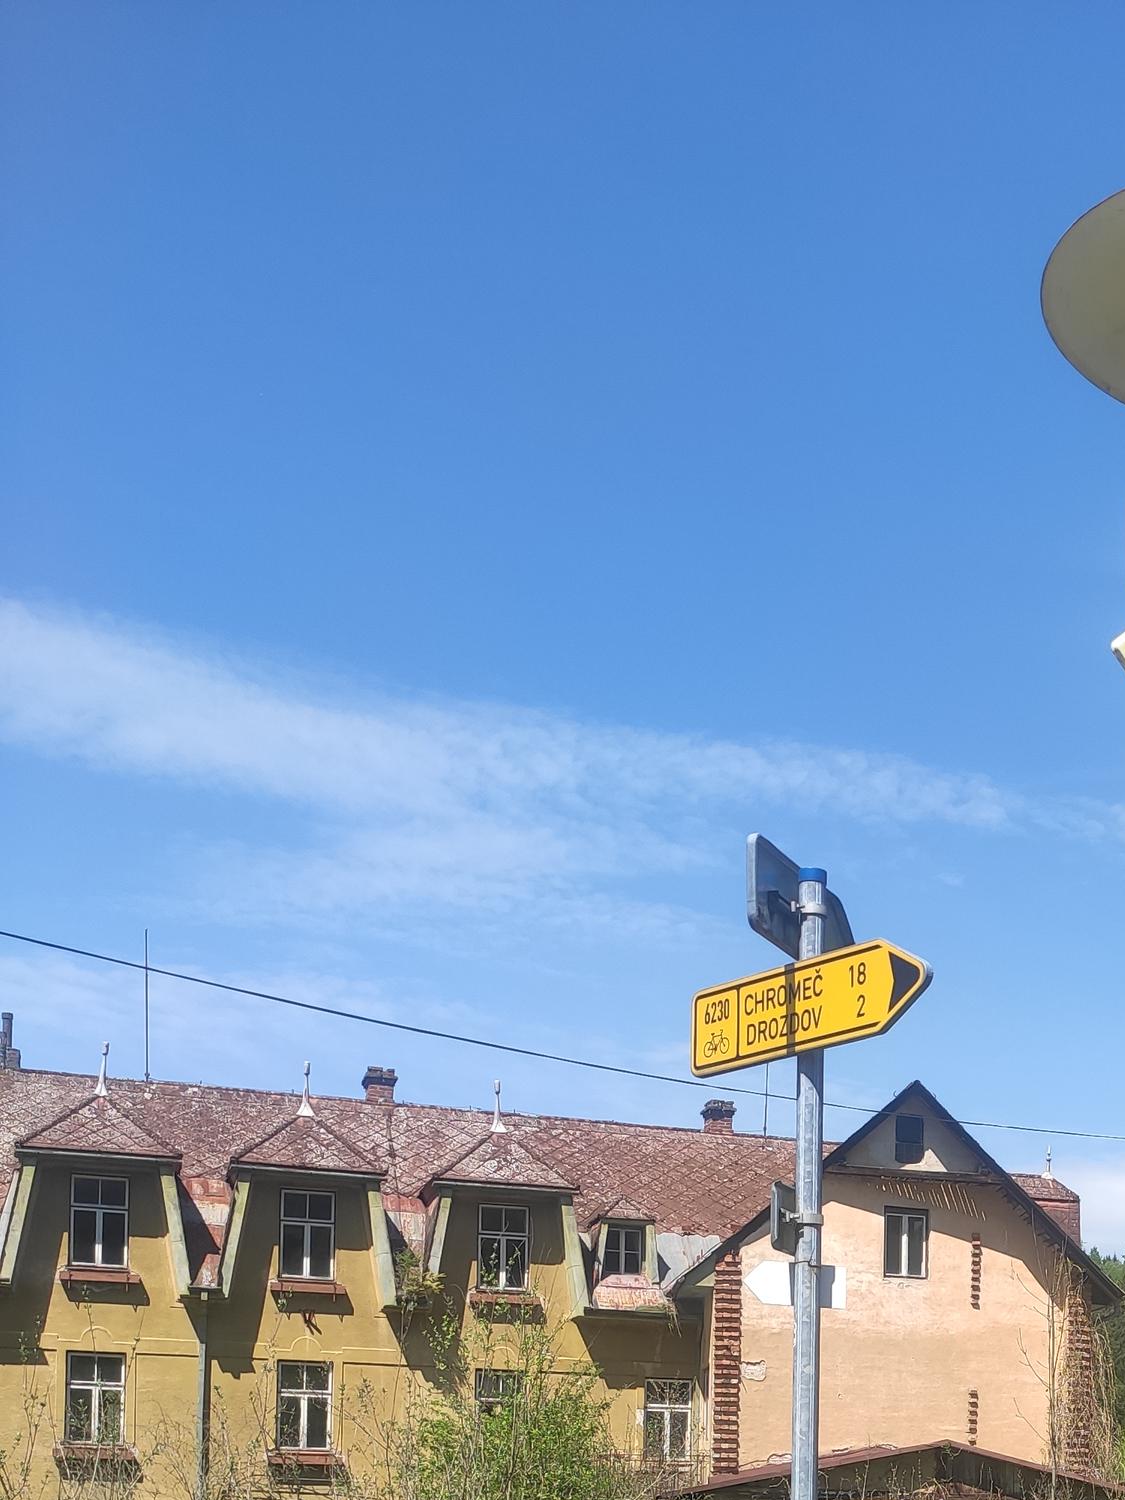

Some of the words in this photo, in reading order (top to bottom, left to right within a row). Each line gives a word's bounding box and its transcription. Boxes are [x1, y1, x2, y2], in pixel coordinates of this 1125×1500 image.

[704, 998, 730, 1025] 6230
[744, 968, 824, 1016] CHROMEČ
[849, 962, 866, 988] 18
[746, 1005, 822, 1046] DROZDOV
[856, 994, 866, 1018] 2
